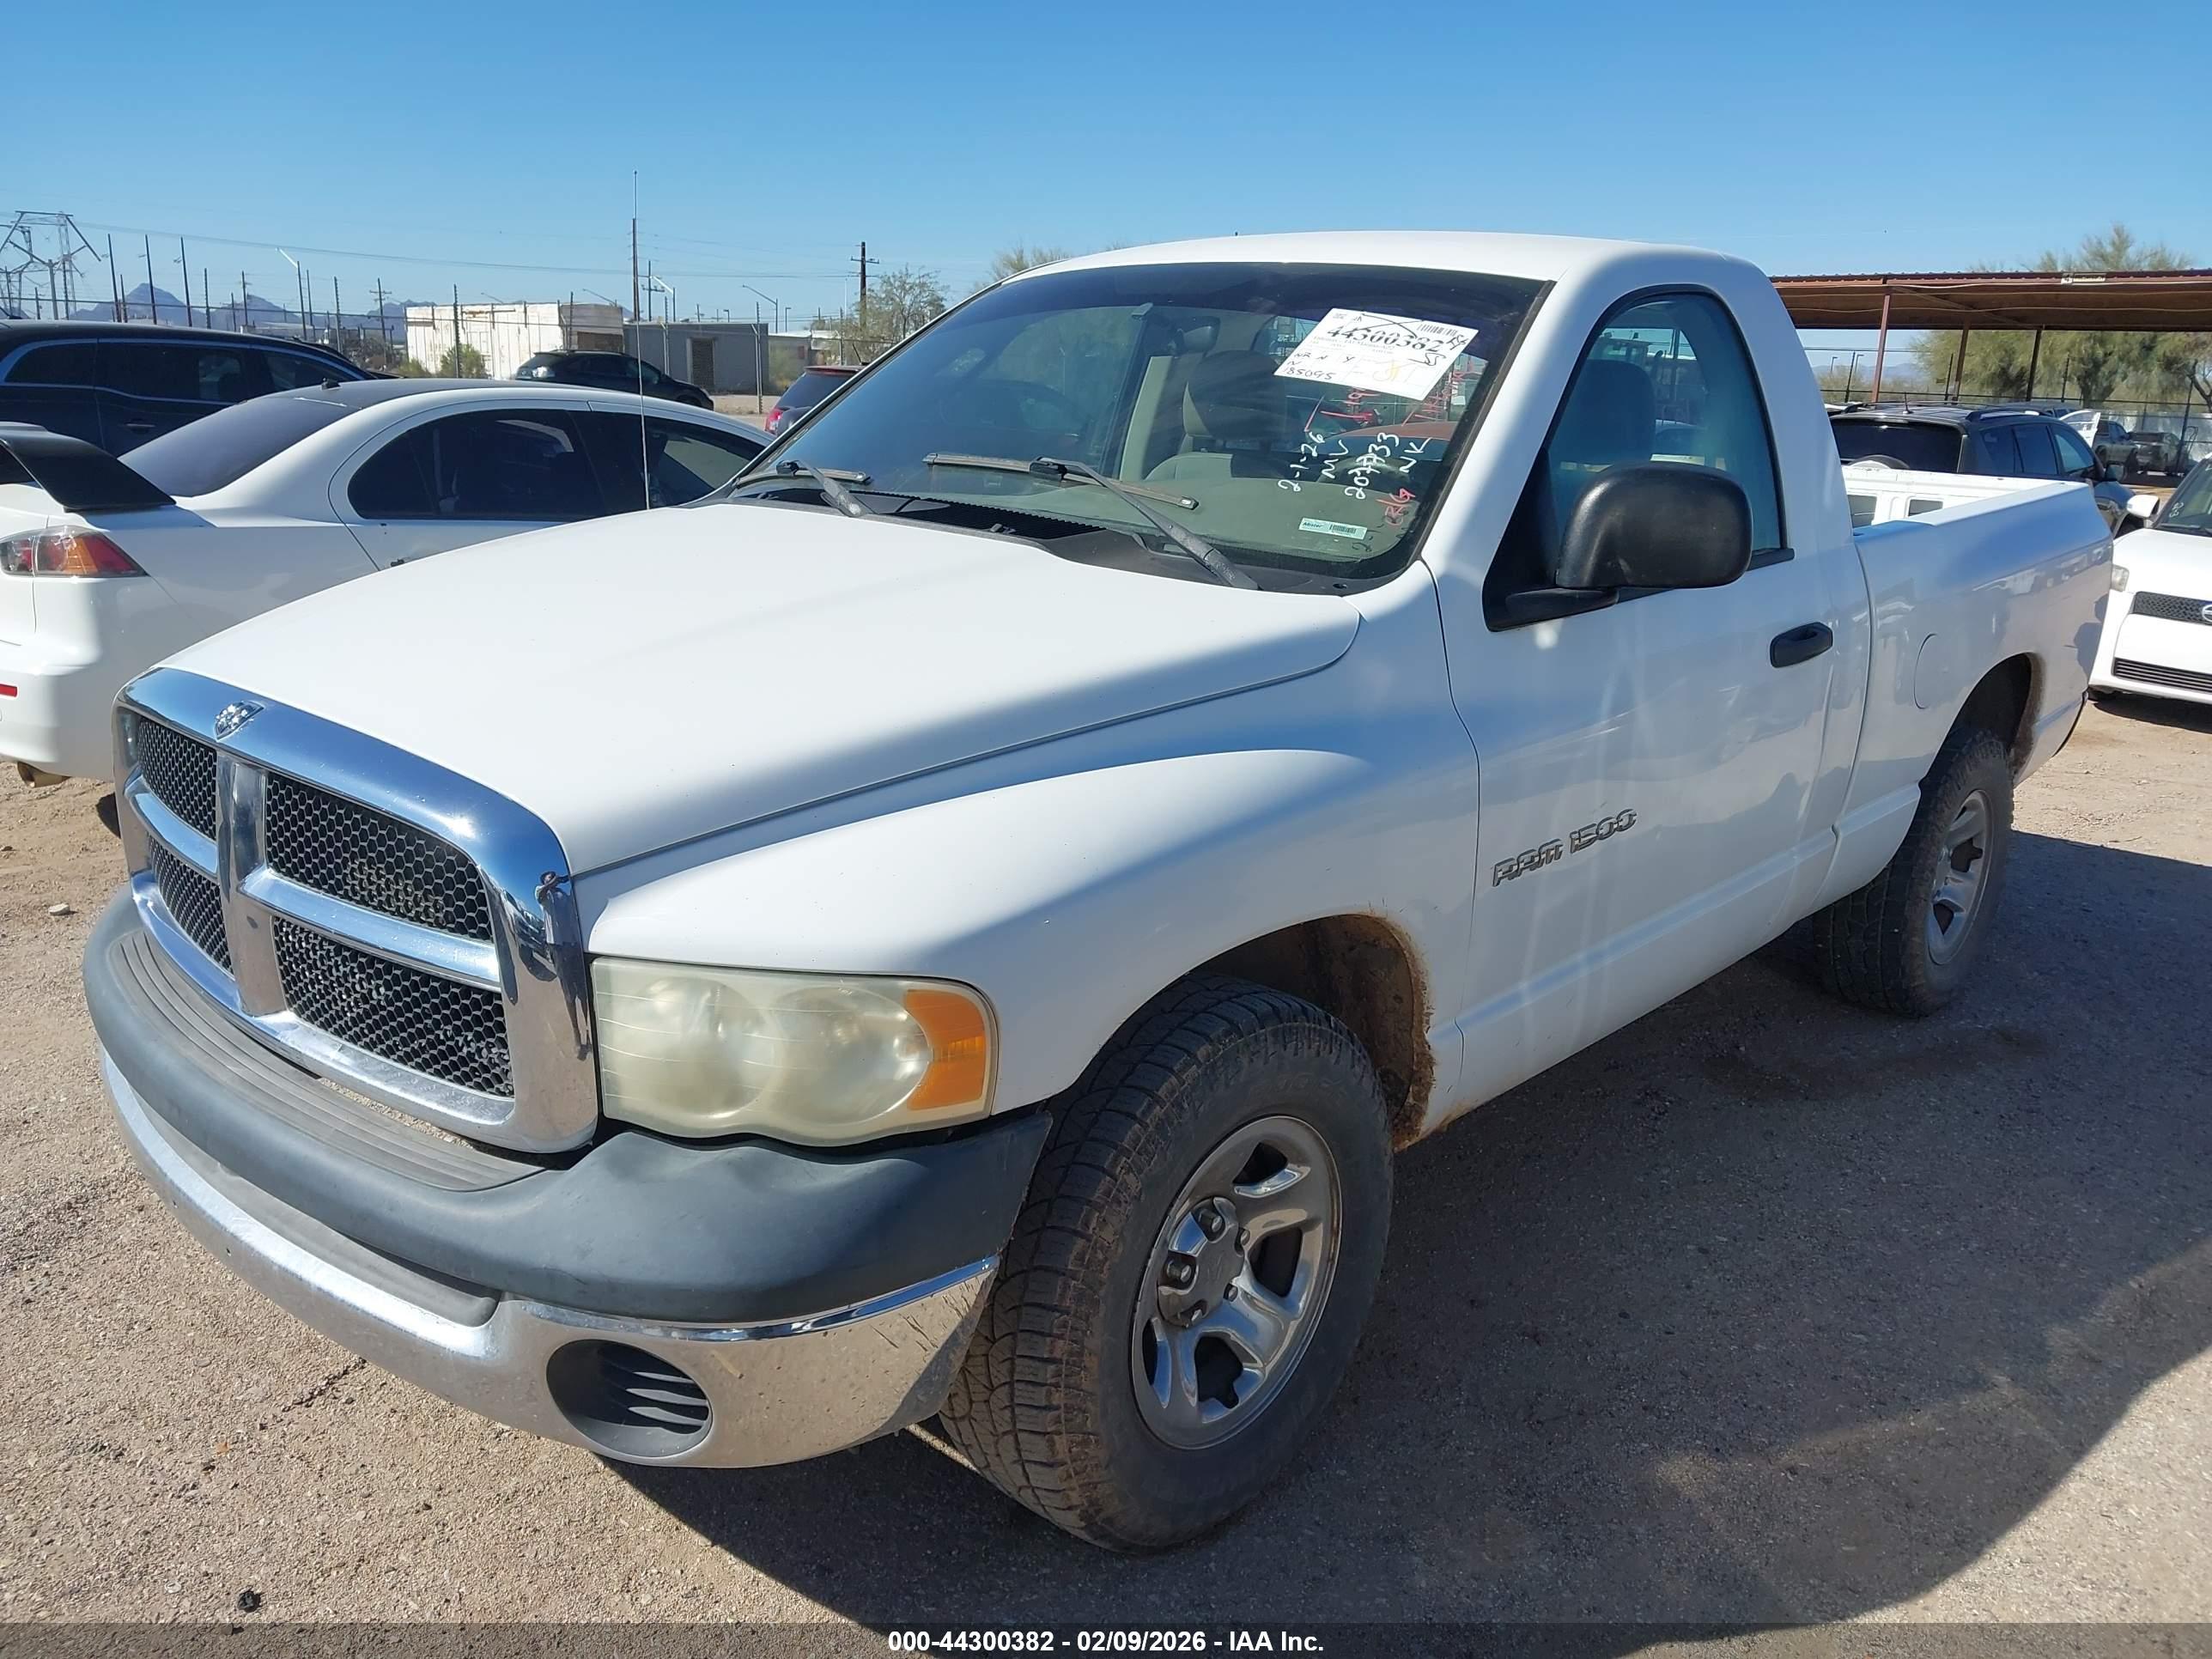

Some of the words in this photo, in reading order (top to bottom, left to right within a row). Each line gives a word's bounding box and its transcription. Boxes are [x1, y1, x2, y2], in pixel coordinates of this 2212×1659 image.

[1328, 325, 1446, 352] 44300382
[1278, 431, 1326, 492] 2-1-26
[1492, 837, 1565, 888] RAM
[1569, 808, 1638, 854] 1500
